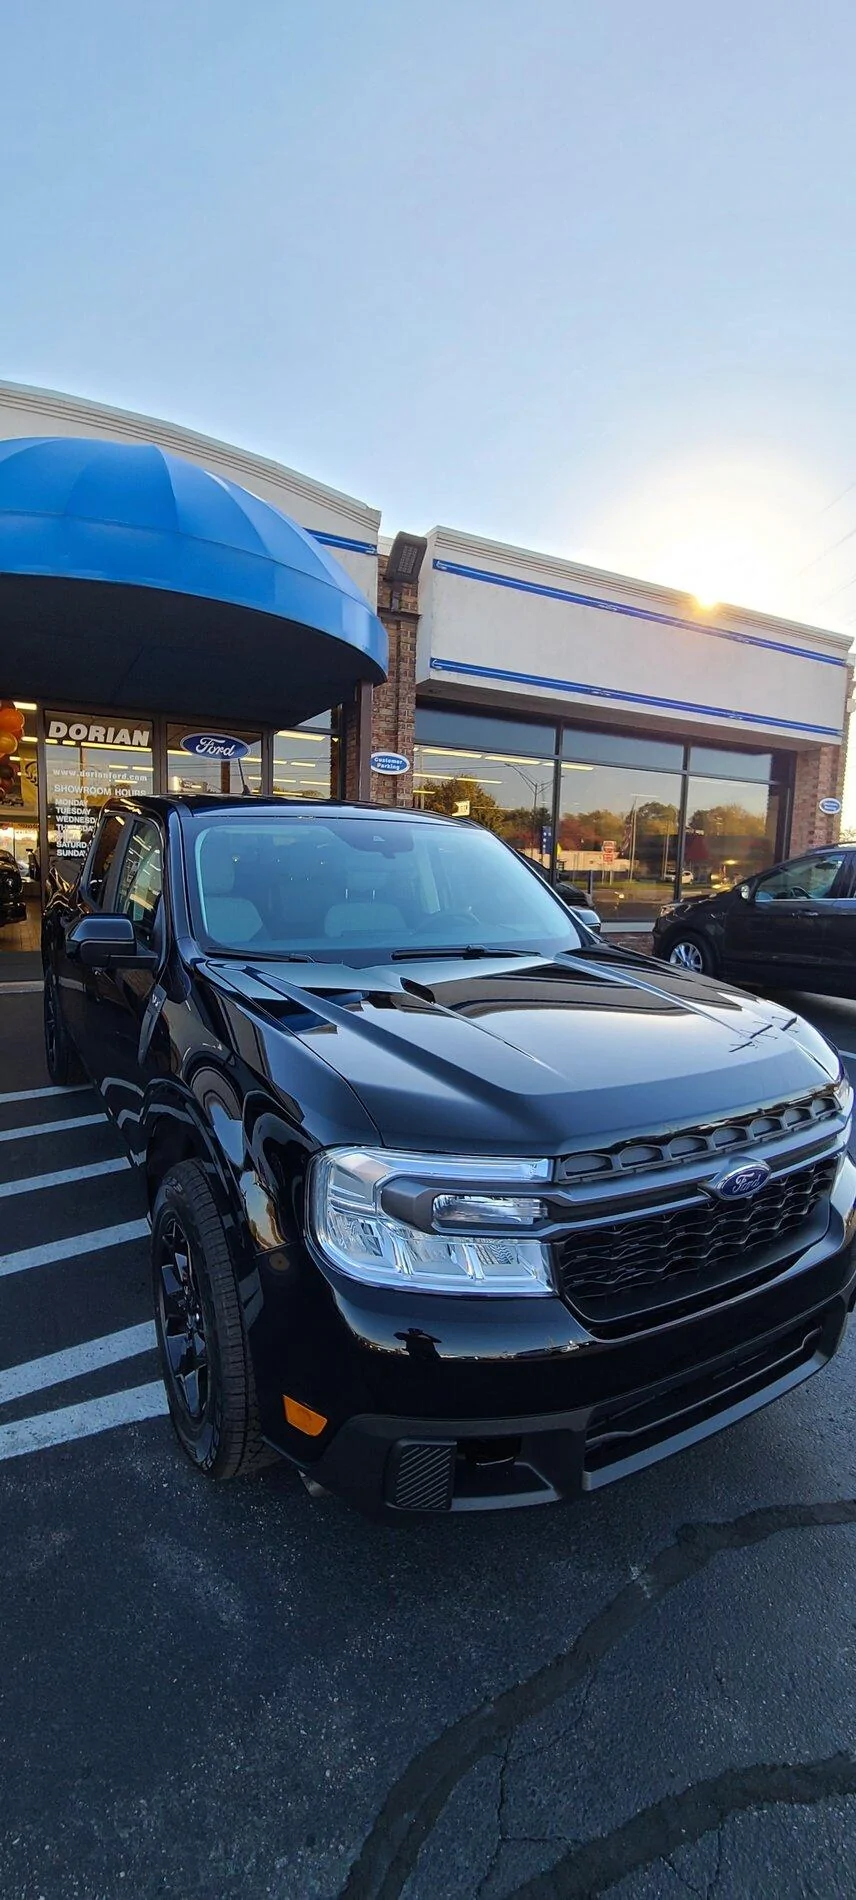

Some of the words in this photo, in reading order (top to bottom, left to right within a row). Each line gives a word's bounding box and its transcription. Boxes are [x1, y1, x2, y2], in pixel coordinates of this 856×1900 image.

[48, 721, 150, 746] DORIAN
[195, 737, 237, 757] Ford
[374, 757, 403, 765] Customer
[376, 762, 400, 771] Parking
[53, 769, 148, 781] www.dorianford.com
[54, 784, 112, 796] SHOWROOM
[115, 788, 147, 798] HOURS
[55, 798, 88, 807] MONDAY
[55, 806, 92, 815] TUESDAY
[55, 815, 96, 824] WEDNESD
[56, 841, 87, 849] SATURD
[732, 1172, 761, 1193] Ford
